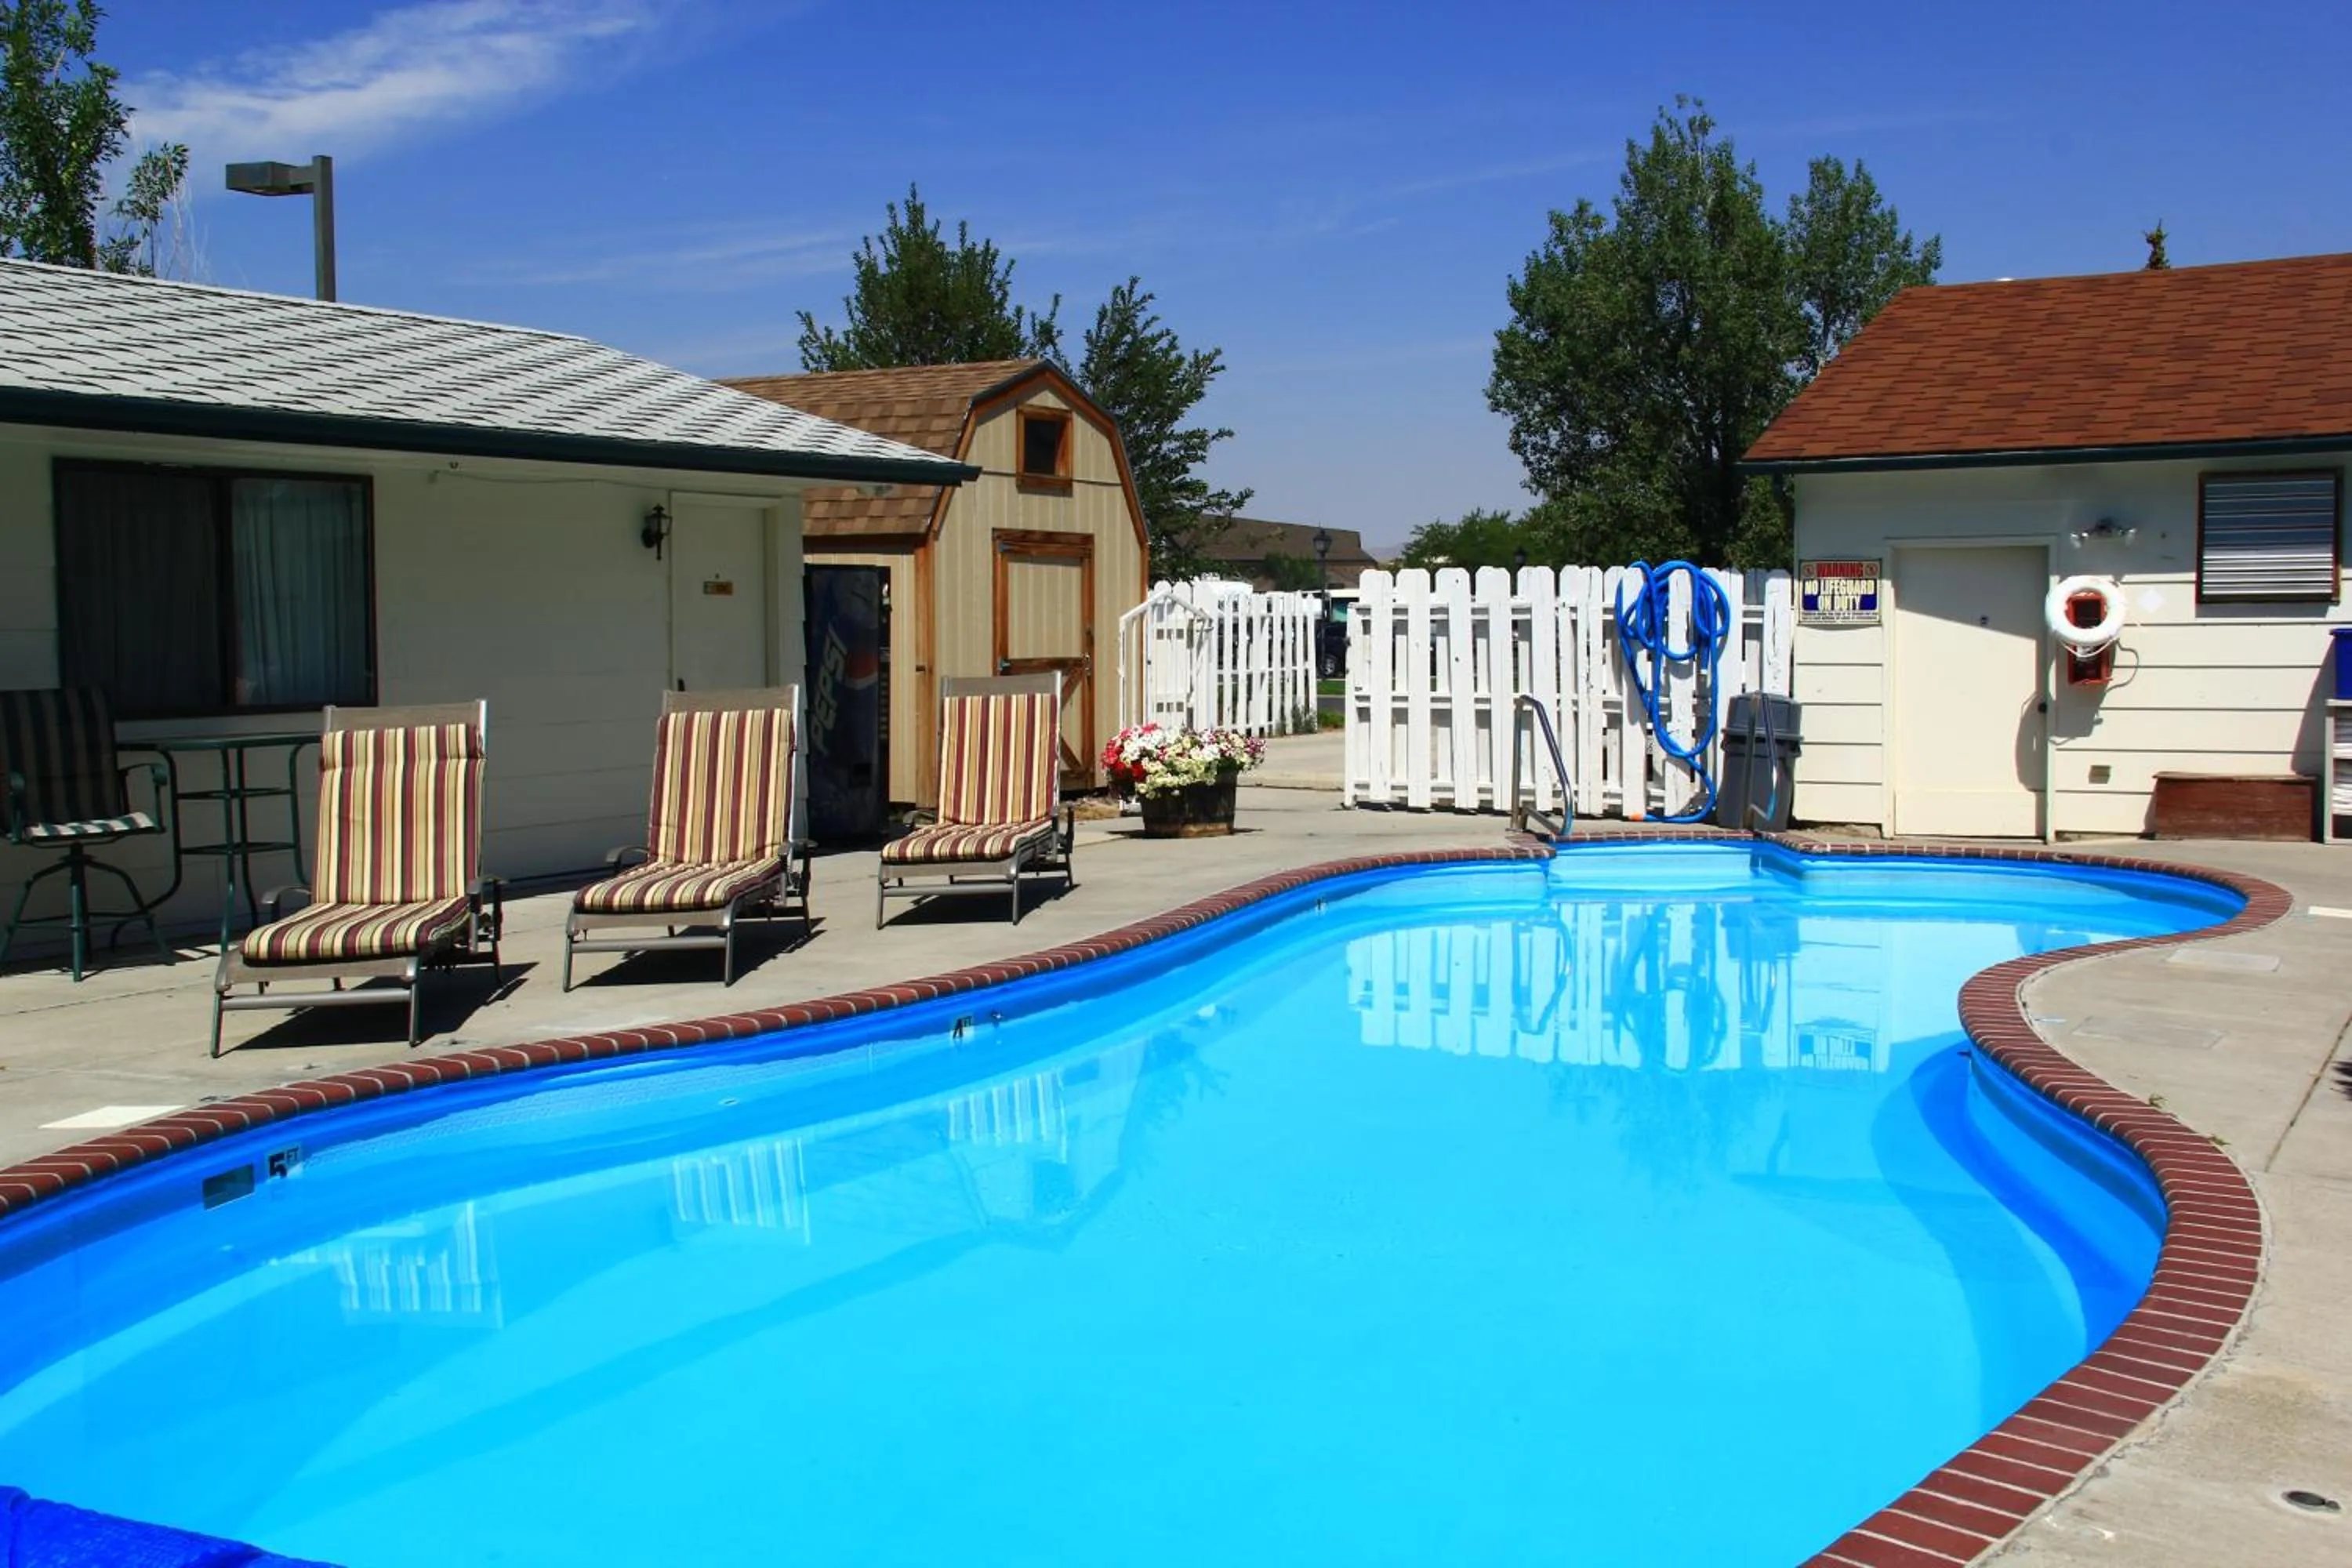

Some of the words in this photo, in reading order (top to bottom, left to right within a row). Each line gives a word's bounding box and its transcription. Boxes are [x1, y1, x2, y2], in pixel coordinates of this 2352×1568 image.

[1804, 580, 1819, 595] NO
[1820, 579, 1875, 595] LIFEGUARD
[1818, 595, 1832, 611] ON
[1834, 595, 1861, 611] DUTY
[811, 621, 848, 756] PEPSI
